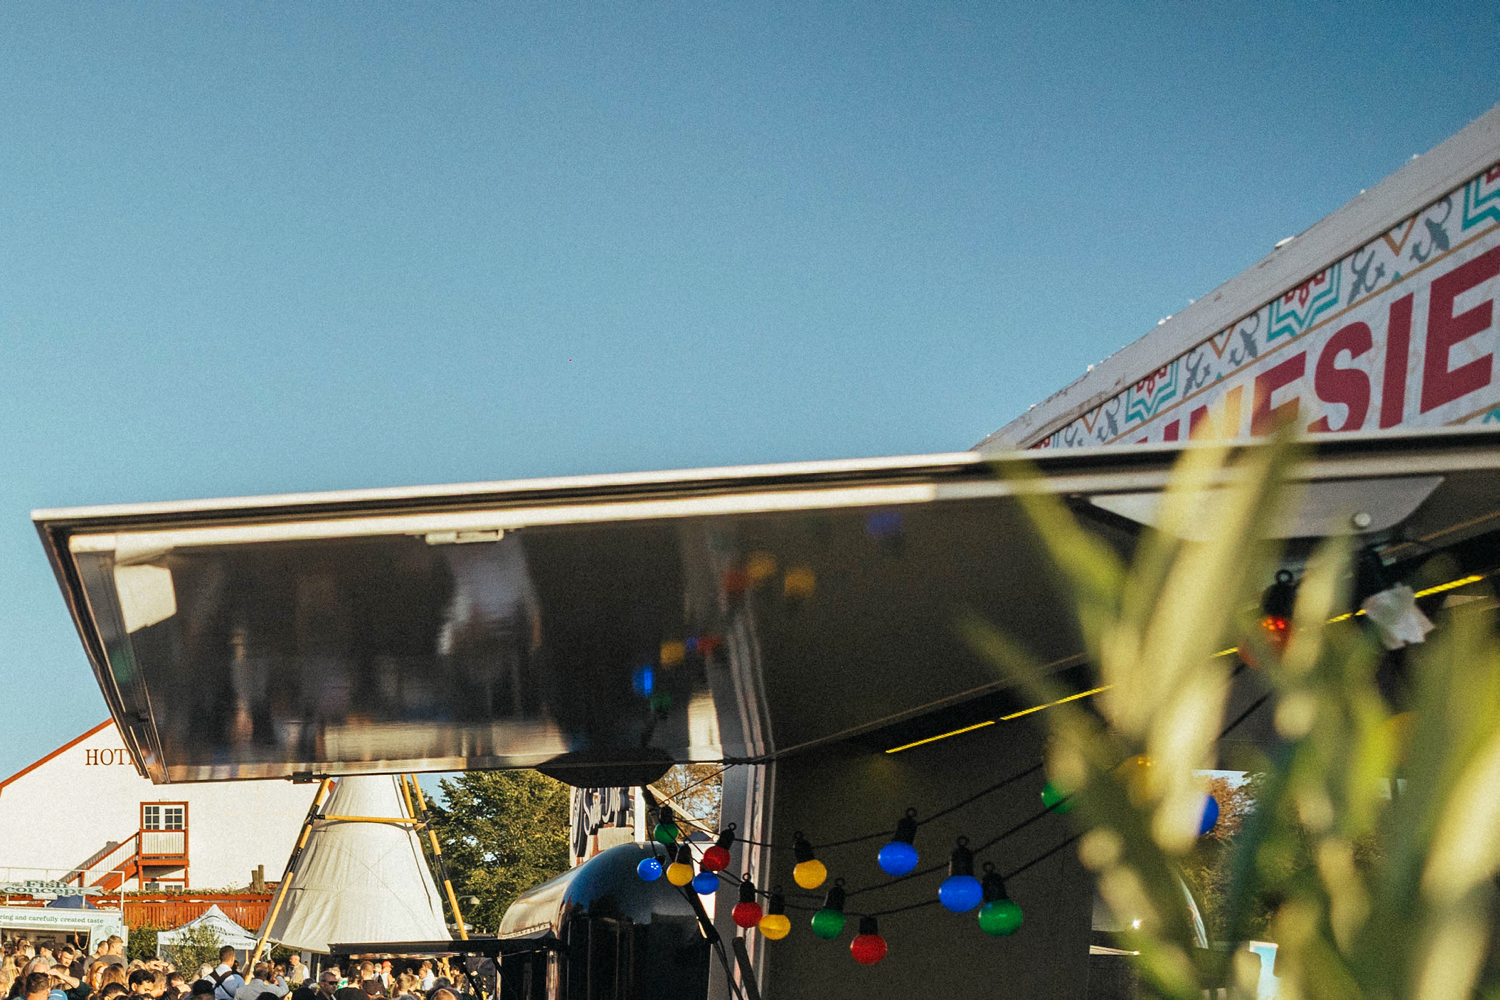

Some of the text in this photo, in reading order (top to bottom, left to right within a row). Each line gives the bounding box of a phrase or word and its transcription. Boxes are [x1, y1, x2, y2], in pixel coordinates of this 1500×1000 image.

[26, 881, 68, 889] Fish
[4, 887, 84, 896] concept
[28, 915, 58, 923] carefully
